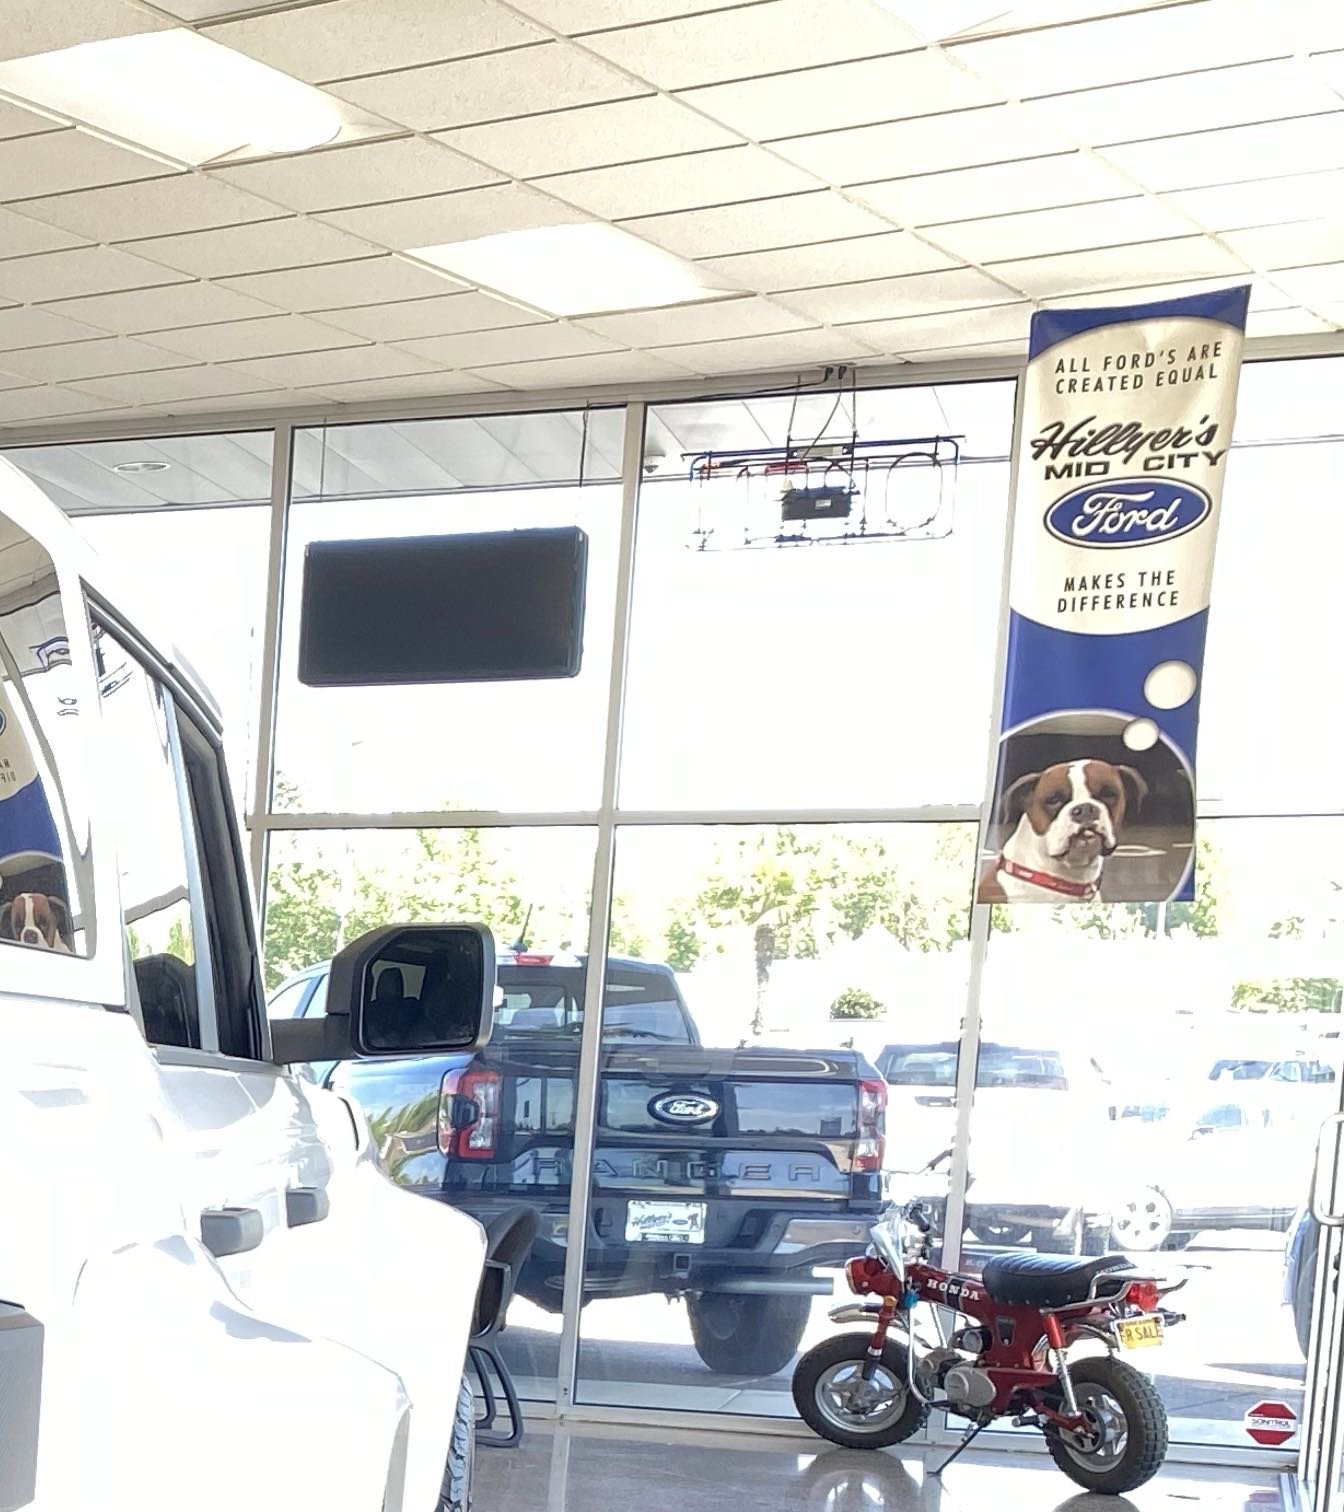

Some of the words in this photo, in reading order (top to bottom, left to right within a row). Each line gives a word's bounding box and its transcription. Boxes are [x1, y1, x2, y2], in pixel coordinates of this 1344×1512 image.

[1055, 357, 1091, 374] ALL
[1103, 348, 1176, 372] FORD'S
[1187, 340, 1223, 362] ARE
[1055, 373, 1144, 395] CREATED
[1155, 362, 1219, 387] EQUAL
[1029, 414, 1219, 465] Hillyer's
[1044, 460, 1111, 481] MID
[1142, 449, 1227, 472] CITY
[1071, 490, 1183, 537] Ford
[1063, 572, 1126, 592] MAKES
[1138, 569, 1176, 587] THE
[1056, 590, 1180, 613] DIFFERENCE
[669, 1099, 707, 1116] Ford
[926, 1278, 981, 1301] HONDA
